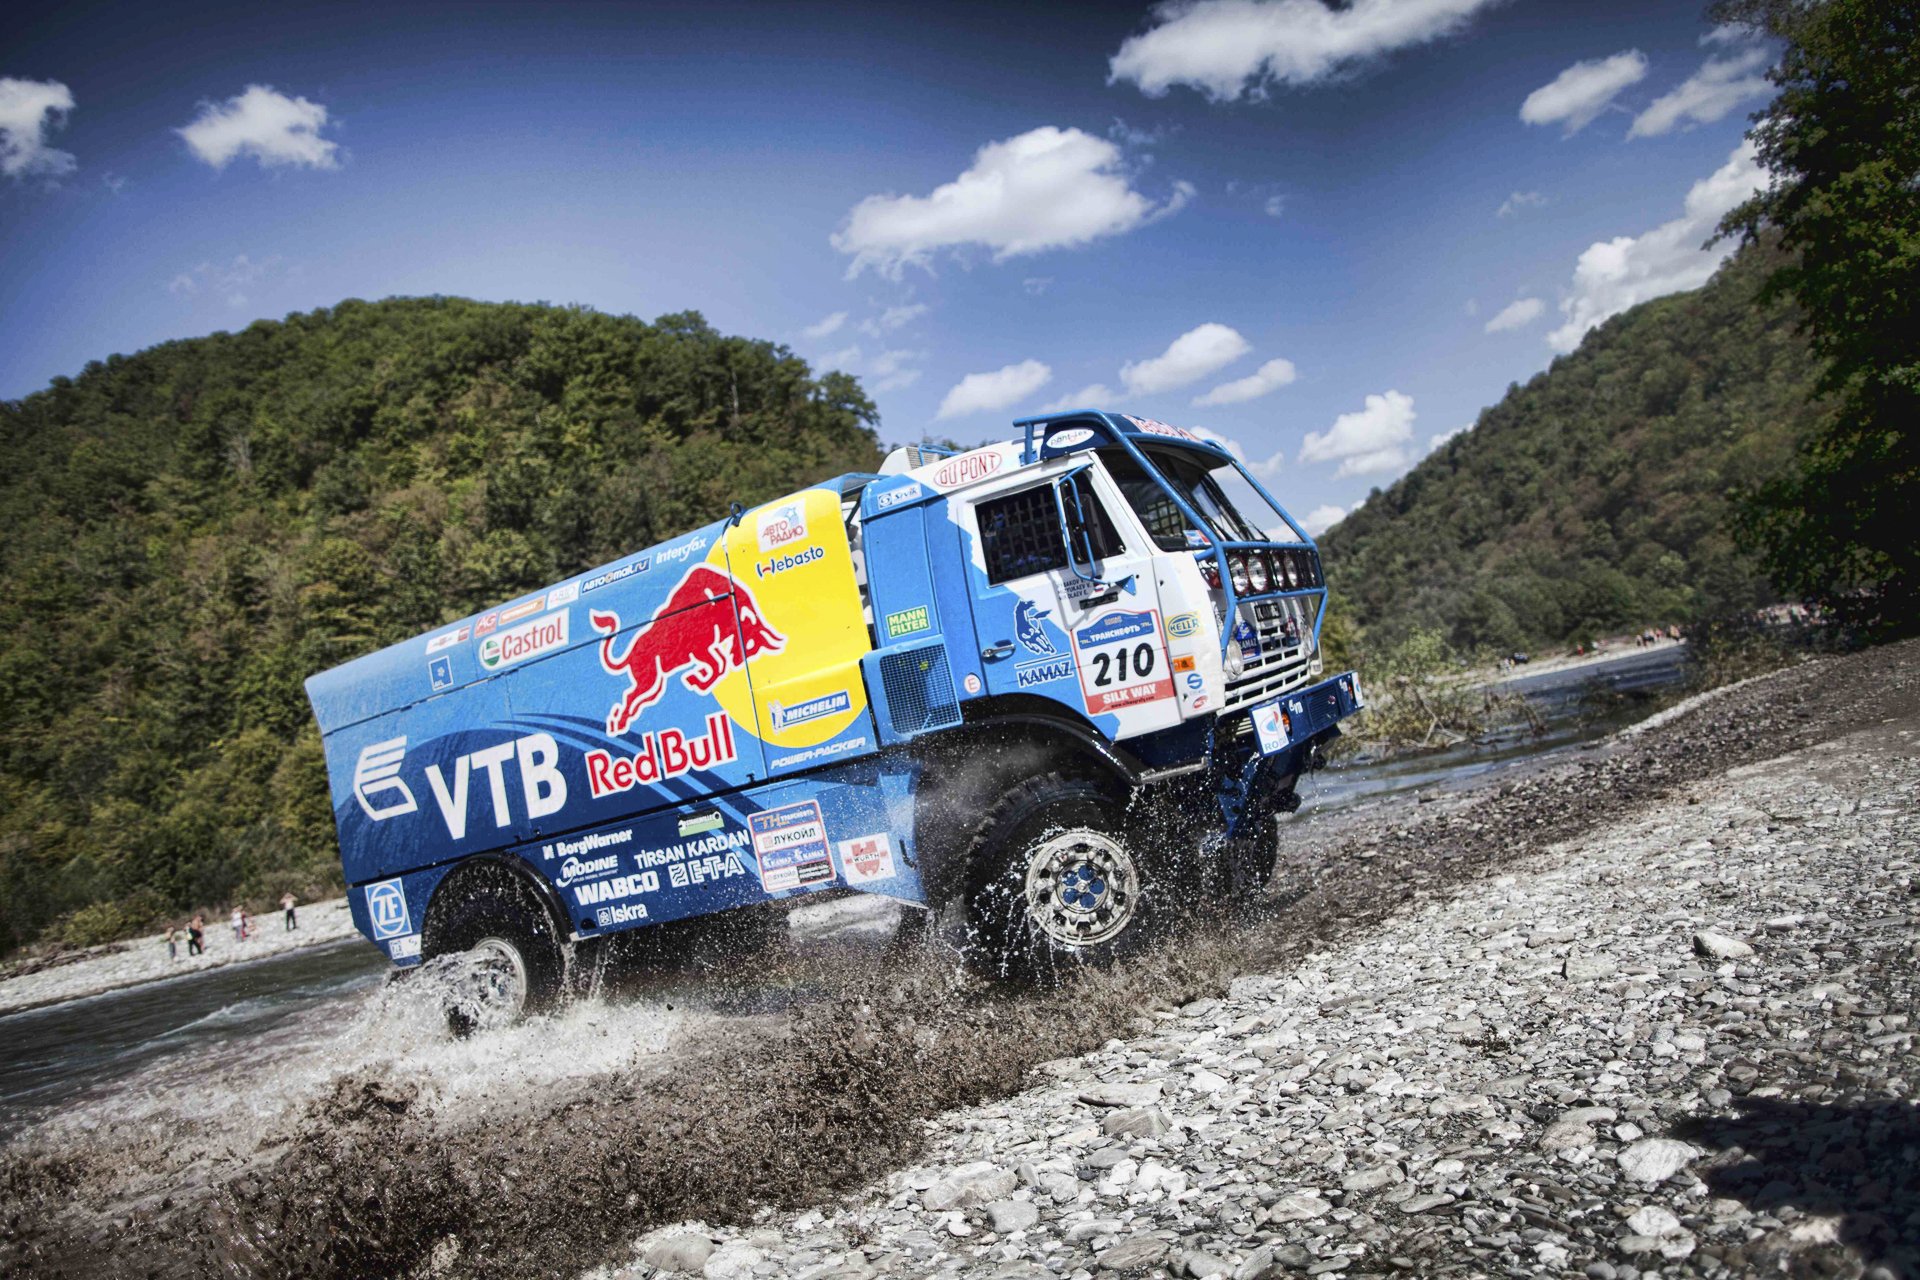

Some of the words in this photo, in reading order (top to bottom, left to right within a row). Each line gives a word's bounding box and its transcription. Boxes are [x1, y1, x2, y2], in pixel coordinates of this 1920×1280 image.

[940, 463, 957, 485] DU
[960, 455, 996, 483] PONT
[763, 520, 789, 539] АВТО
[770, 525, 804, 546] РАДИО
[757, 546, 824, 578] Webasto
[888, 608, 926, 626] MANN
[890, 618, 928, 637] FILTER
[501, 616, 563, 660] Castrol
[1090, 625, 1141, 643] ТРАНСНЕФТЬ
[1018, 661, 1073, 688] KAMAZ
[1092, 643, 1154, 687] 210
[786, 694, 846, 722] MICHELIN
[1103, 689, 1129, 705] SILK
[1130, 683, 1156, 698] WAY
[586, 732, 660, 797] Red
[659, 712, 736, 776] Bull
[770, 737, 866, 769] POWER-PACKER
[424, 733, 567, 840] VTB
[557, 829, 633, 857] BorgWarner
[686, 829, 750, 858] KARDAN
[774, 828, 816, 845] ЛУКОЙЛ
[562, 854, 618, 879] MODINE
[574, 871, 660, 906] WABCO
[372, 891, 403, 926] ZF
[611, 903, 648, 924] Iskra
